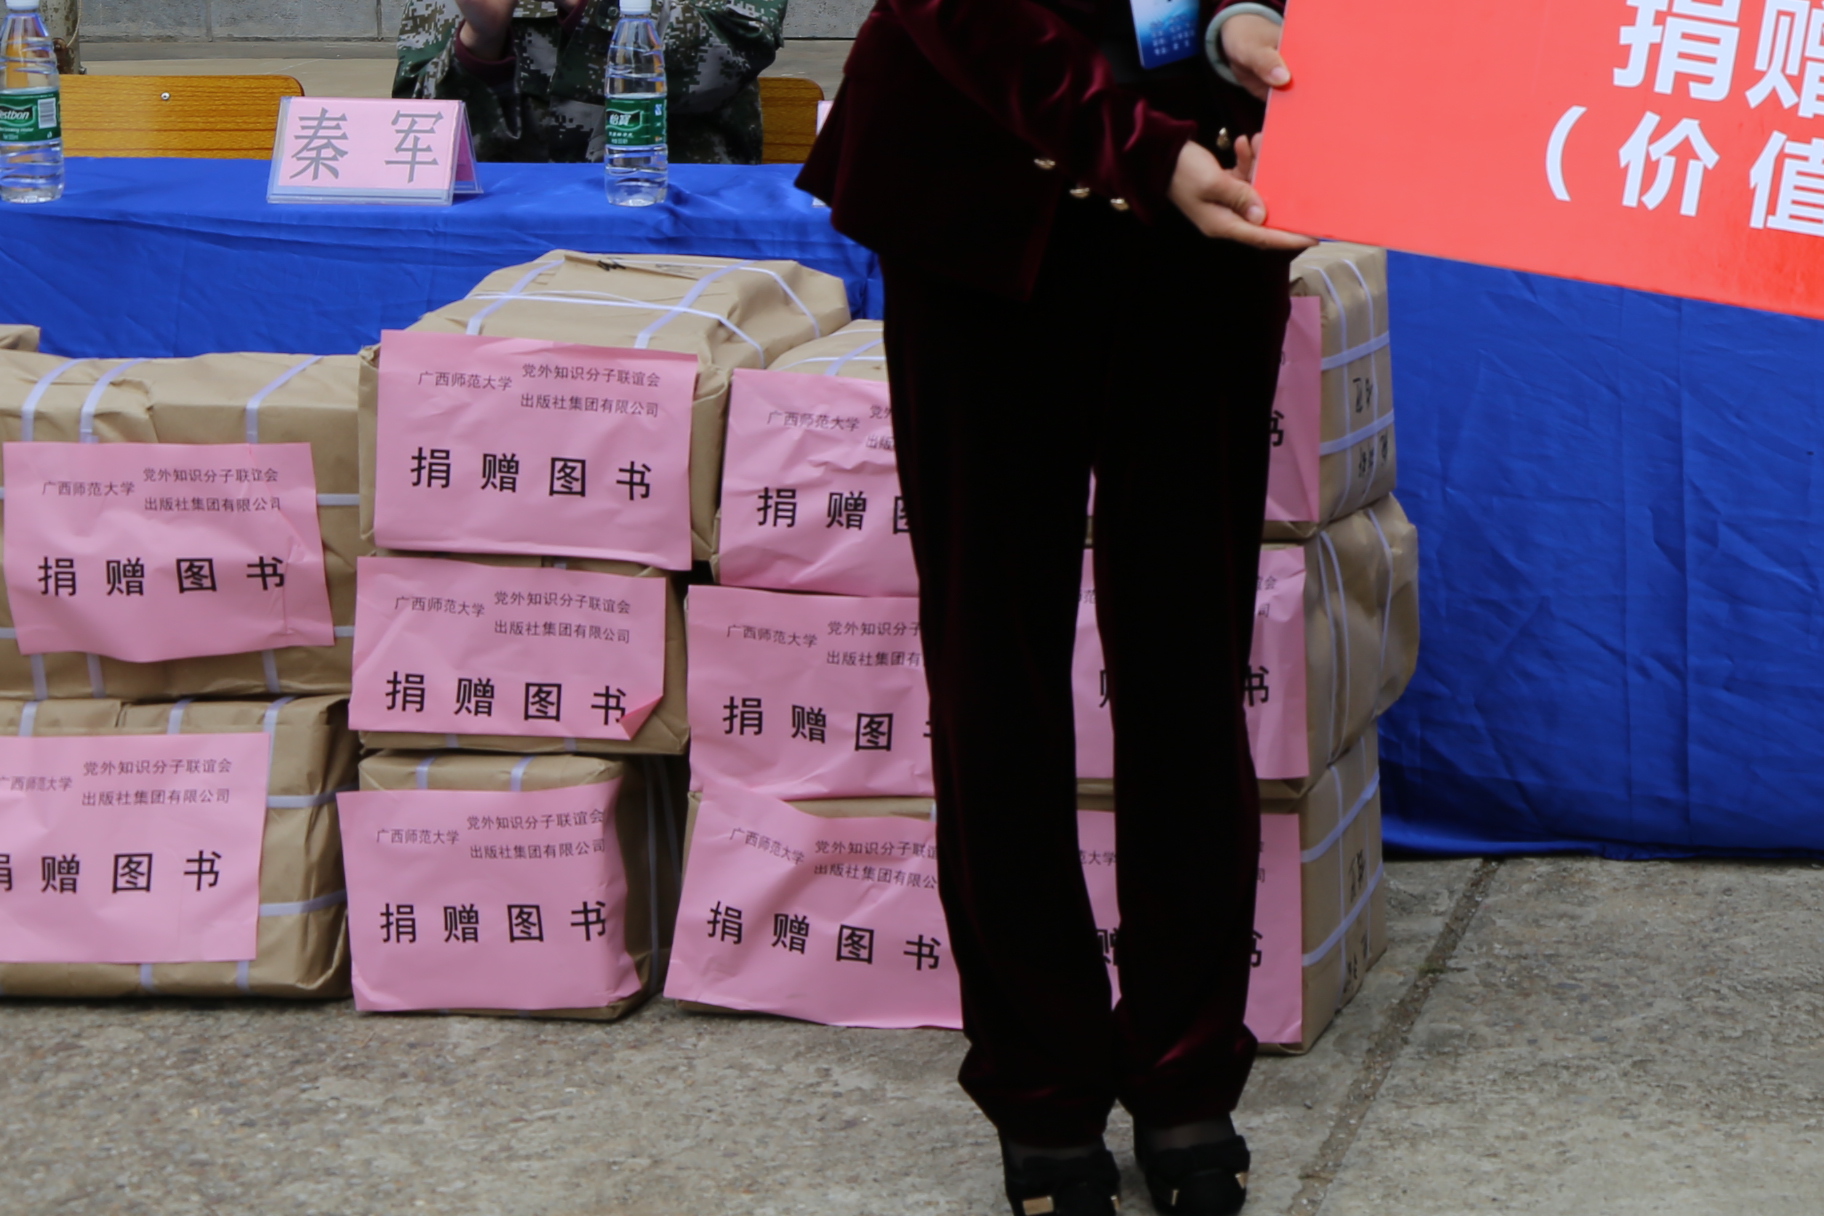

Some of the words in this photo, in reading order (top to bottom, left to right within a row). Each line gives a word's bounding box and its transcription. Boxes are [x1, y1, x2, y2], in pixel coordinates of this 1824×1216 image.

[289, 106, 444, 184] 秦军
[418, 370, 513, 391] 广西师范大学
[521, 363, 661, 387] 党外知识分子联谊会
[520, 393, 659, 418] 出版社集团有限公司
[767, 410, 861, 432] 广西师范大学
[143, 467, 279, 483] 党外知识分子联谊会
[410, 446, 652, 501] 捐赠图书
[42, 481, 136, 497] 广西师范大学
[144, 496, 281, 512] 出版社集团有限公司
[38, 556, 285, 597] 捐赠图书
[394, 596, 486, 617] 广西师范大学
[494, 590, 631, 614] 党外知识分子联谊会
[494, 620, 631, 644] 出版社集团有限公司
[726, 624, 818, 648] 广西师范大学
[385, 671, 627, 726] 捐赠图书
[722, 696, 931, 752] 捐赠图
[83, 757, 232, 777] 党外知识分子联谊会
[81, 788, 230, 806] 出版社集团有限公司
[466, 807, 605, 831] 党外知识分子联谊会
[376, 828, 460, 845] 广西师范大学
[469, 838, 606, 859] 出版社集团有限公司
[729, 827, 806, 866] 广西师范大学
[380, 900, 607, 942] 捐赠图书
[706, 900, 941, 971] 捐赠图书
